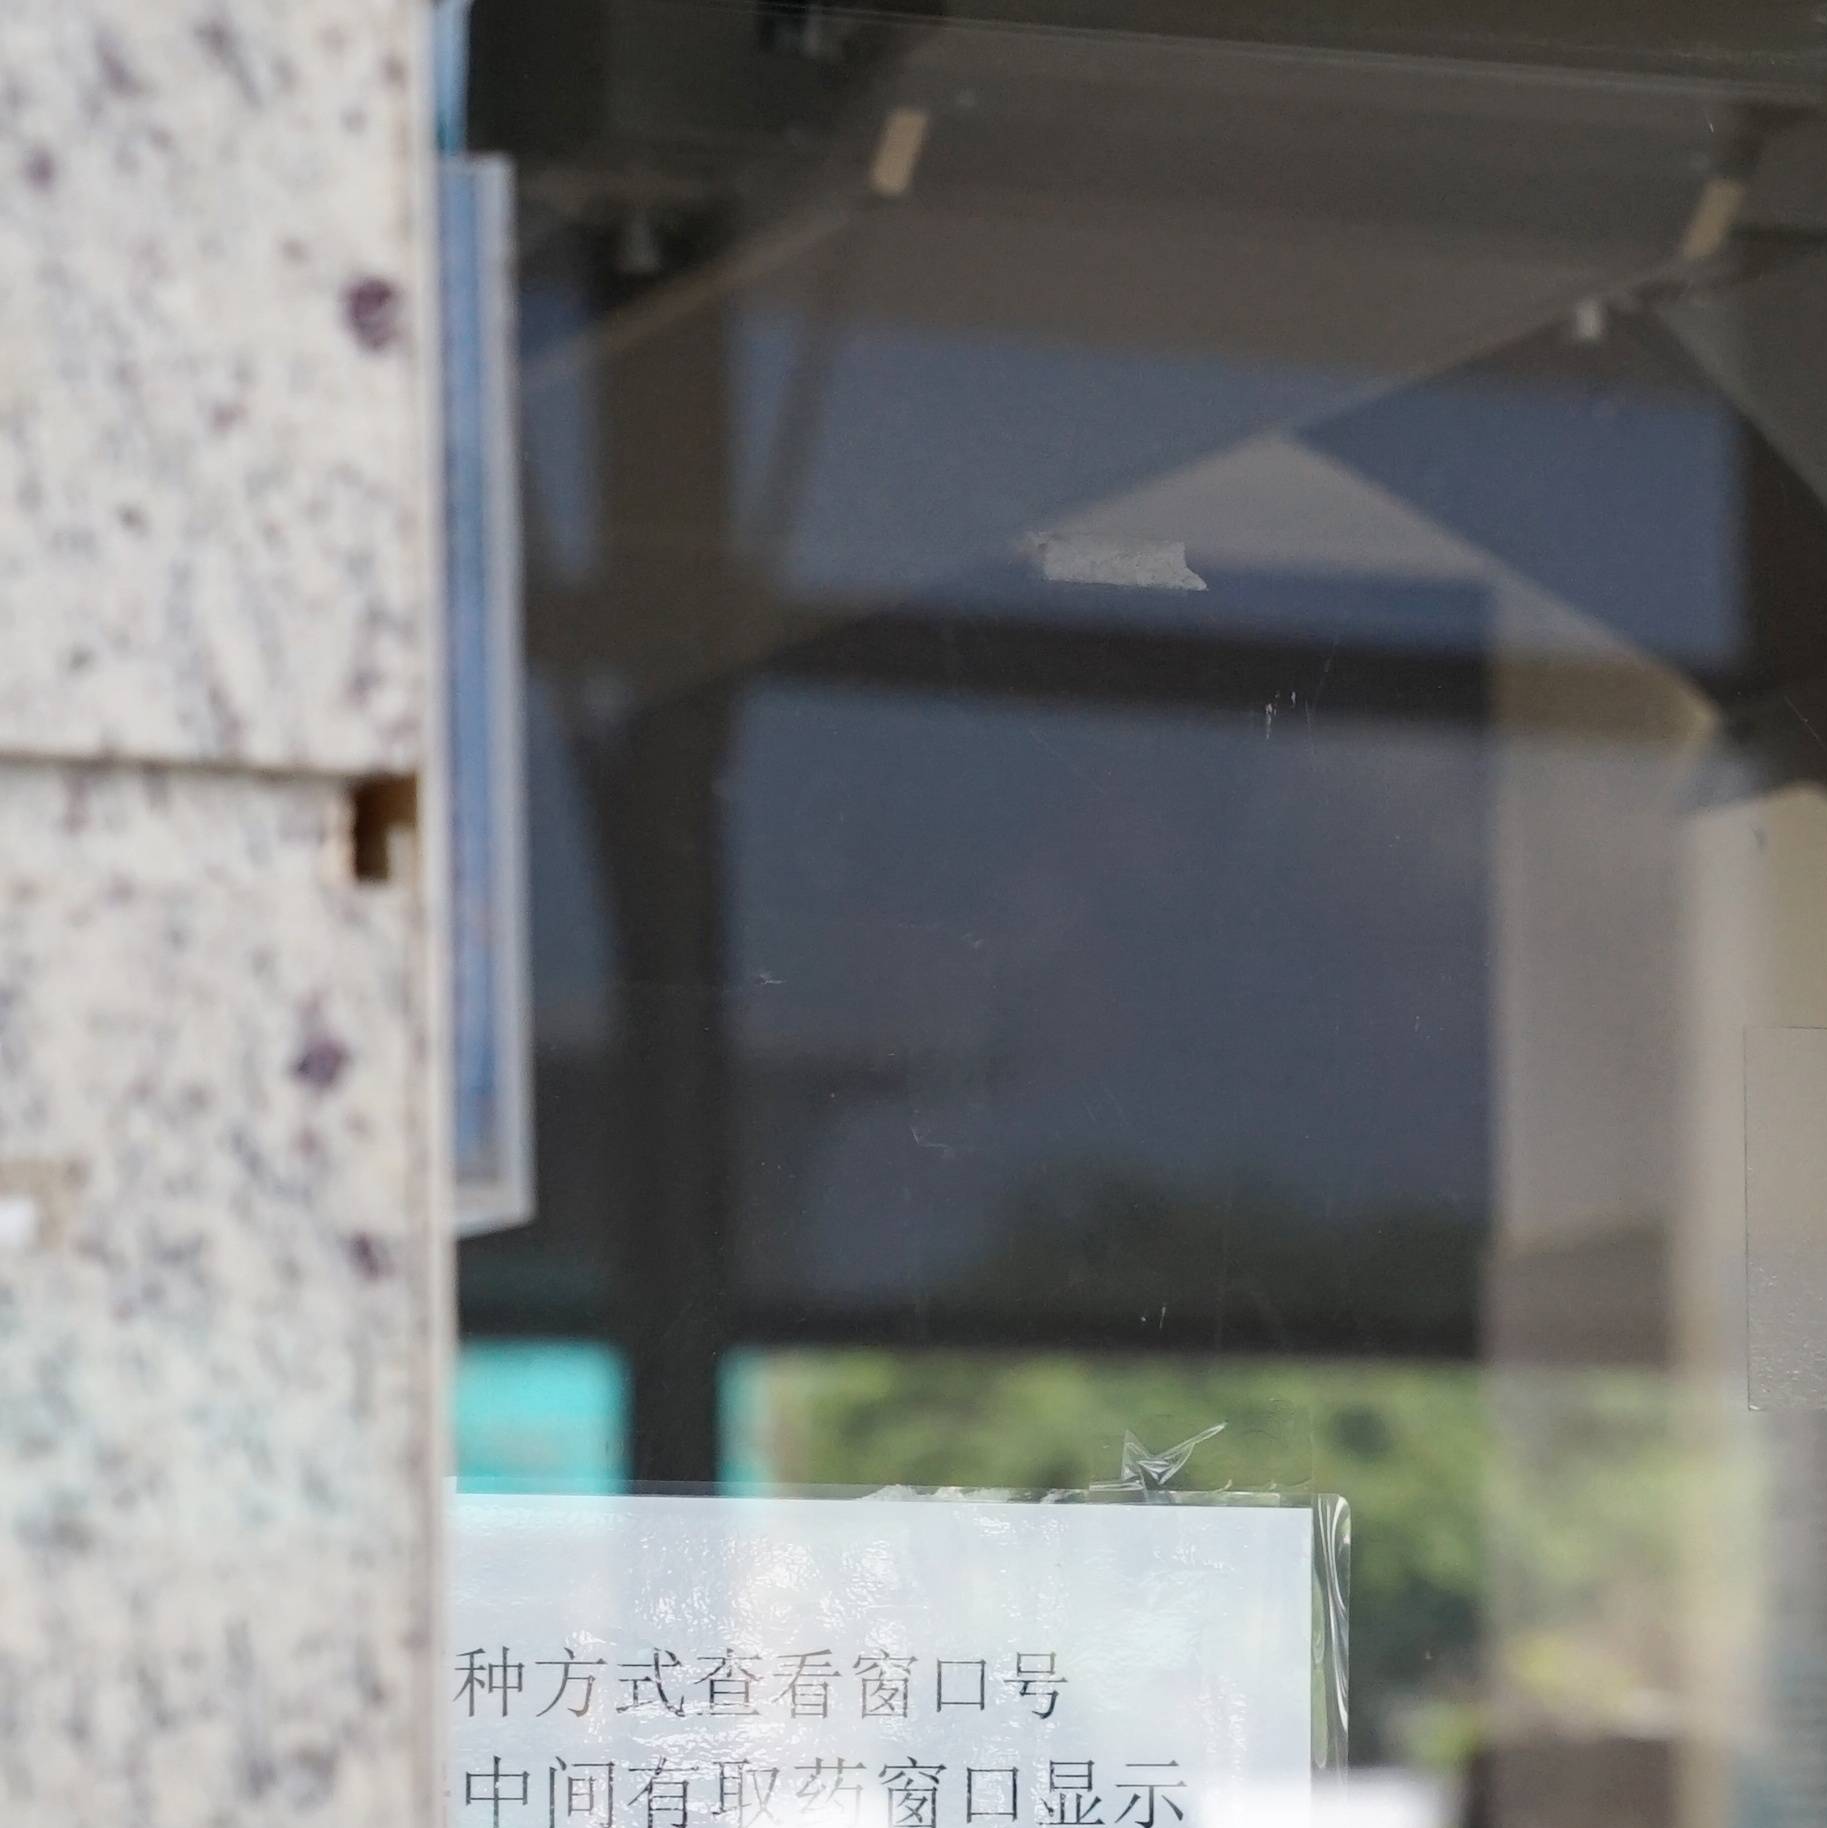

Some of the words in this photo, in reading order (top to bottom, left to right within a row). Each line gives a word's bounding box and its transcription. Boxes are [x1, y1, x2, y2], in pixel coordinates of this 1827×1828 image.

[452, 1647, 1069, 1720] 种方式查看窗口号
